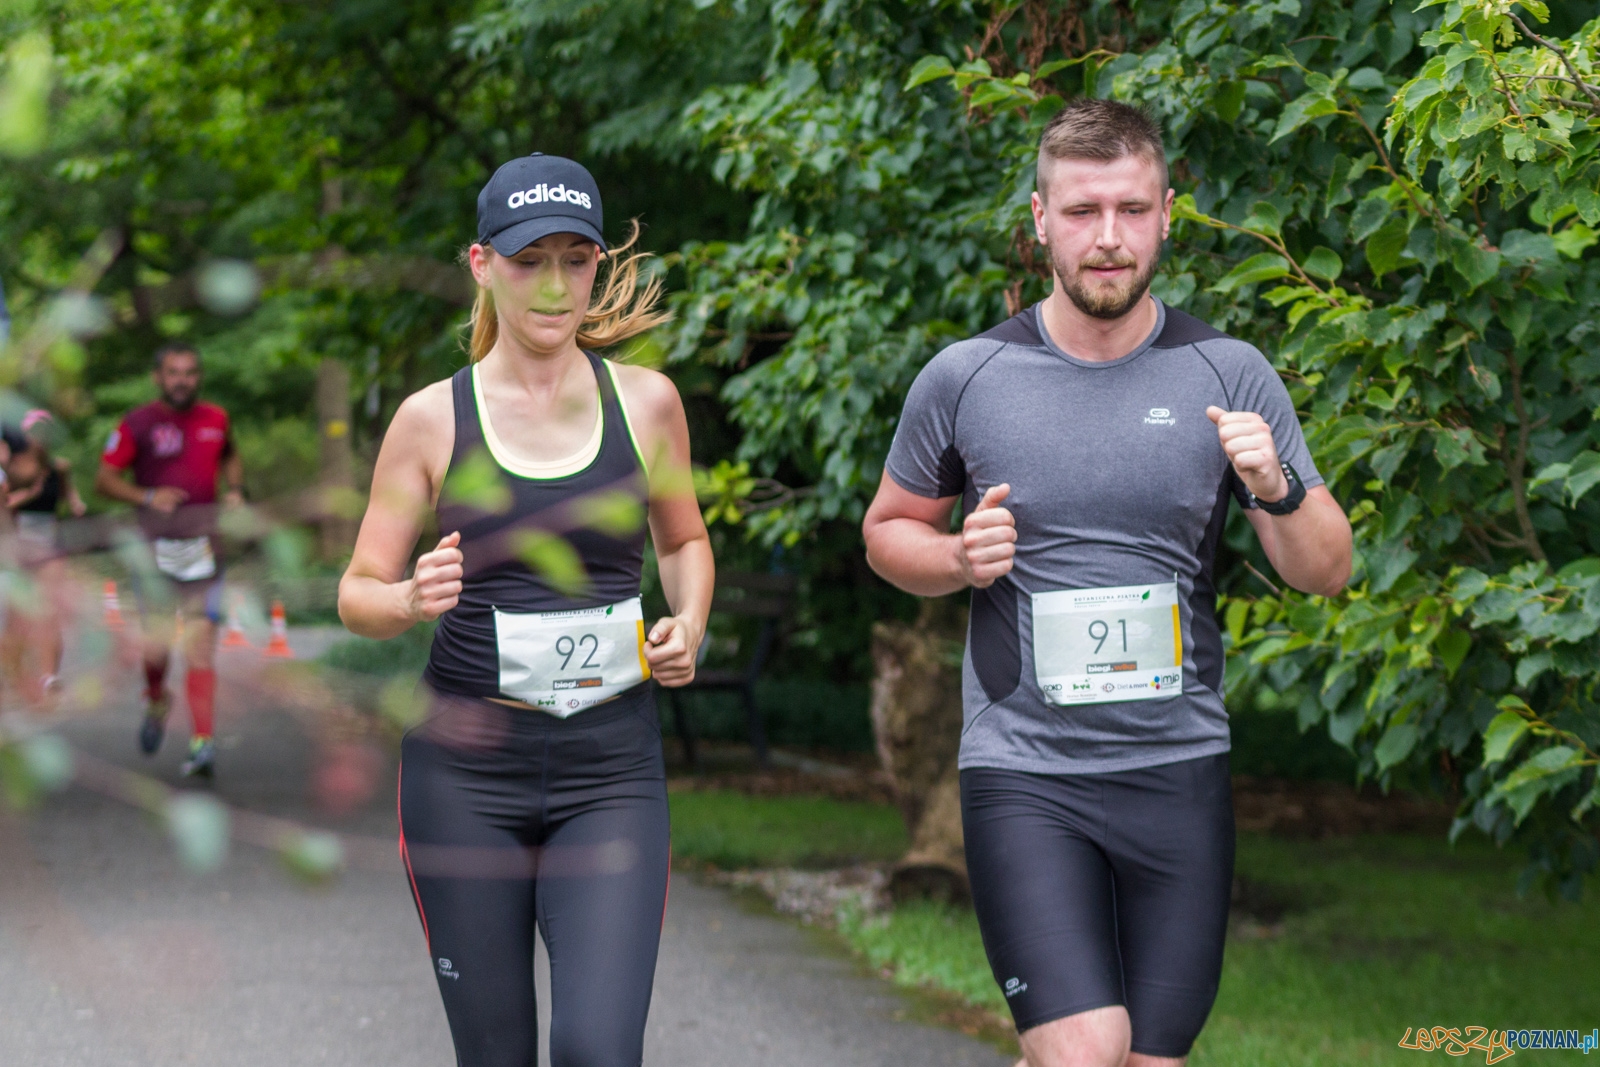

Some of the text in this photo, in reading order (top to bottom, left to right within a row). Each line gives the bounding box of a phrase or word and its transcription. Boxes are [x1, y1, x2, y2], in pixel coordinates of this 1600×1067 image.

[507, 183, 592, 210] adidas
[1144, 417, 1176, 426] Kalenji
[555, 633, 602, 671] 92
[1088, 618, 1128, 655] 91
